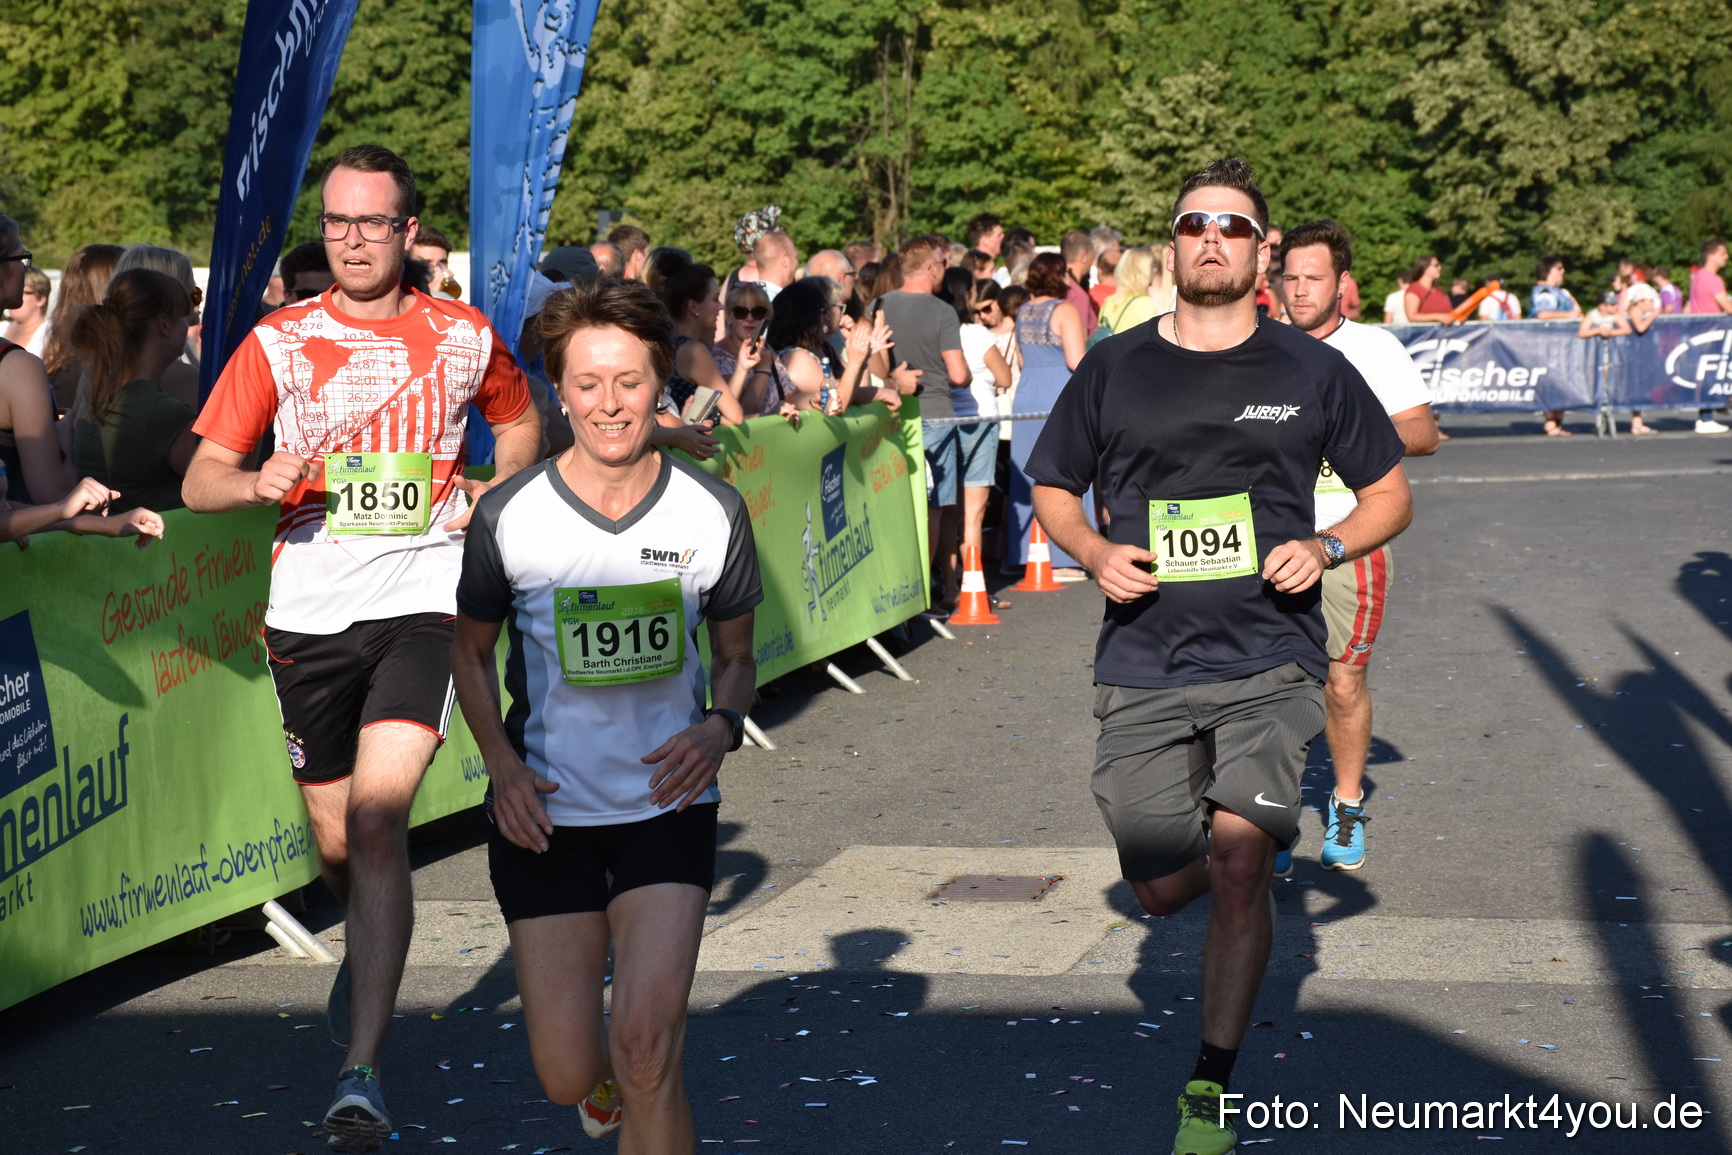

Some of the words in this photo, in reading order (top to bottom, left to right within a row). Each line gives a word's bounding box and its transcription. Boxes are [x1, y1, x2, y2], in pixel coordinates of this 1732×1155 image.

[347, 393, 379, 403] 26.22
[1234, 405, 1282, 422] JURA
[340, 465, 377, 474] firmenlauf
[340, 482, 419, 511] 1850
[353, 512, 372, 521] Matz
[374, 512, 408, 520] Dominic
[1162, 524, 1242, 558] 1094
[641, 547, 680, 563] swn
[1165, 559, 1198, 567] Schauer
[1200, 556, 1241, 566] Sebastian
[102, 552, 191, 646] Gesunde
[194, 539, 257, 598] Firmen
[571, 601, 616, 611] firmenlauf
[572, 616, 670, 658] 1916
[151, 624, 212, 697] laufen
[212, 600, 268, 664] länge
[583, 659, 611, 669] Barth
[613, 654, 662, 667] Christiane
[644, 663, 662, 671] Energie
